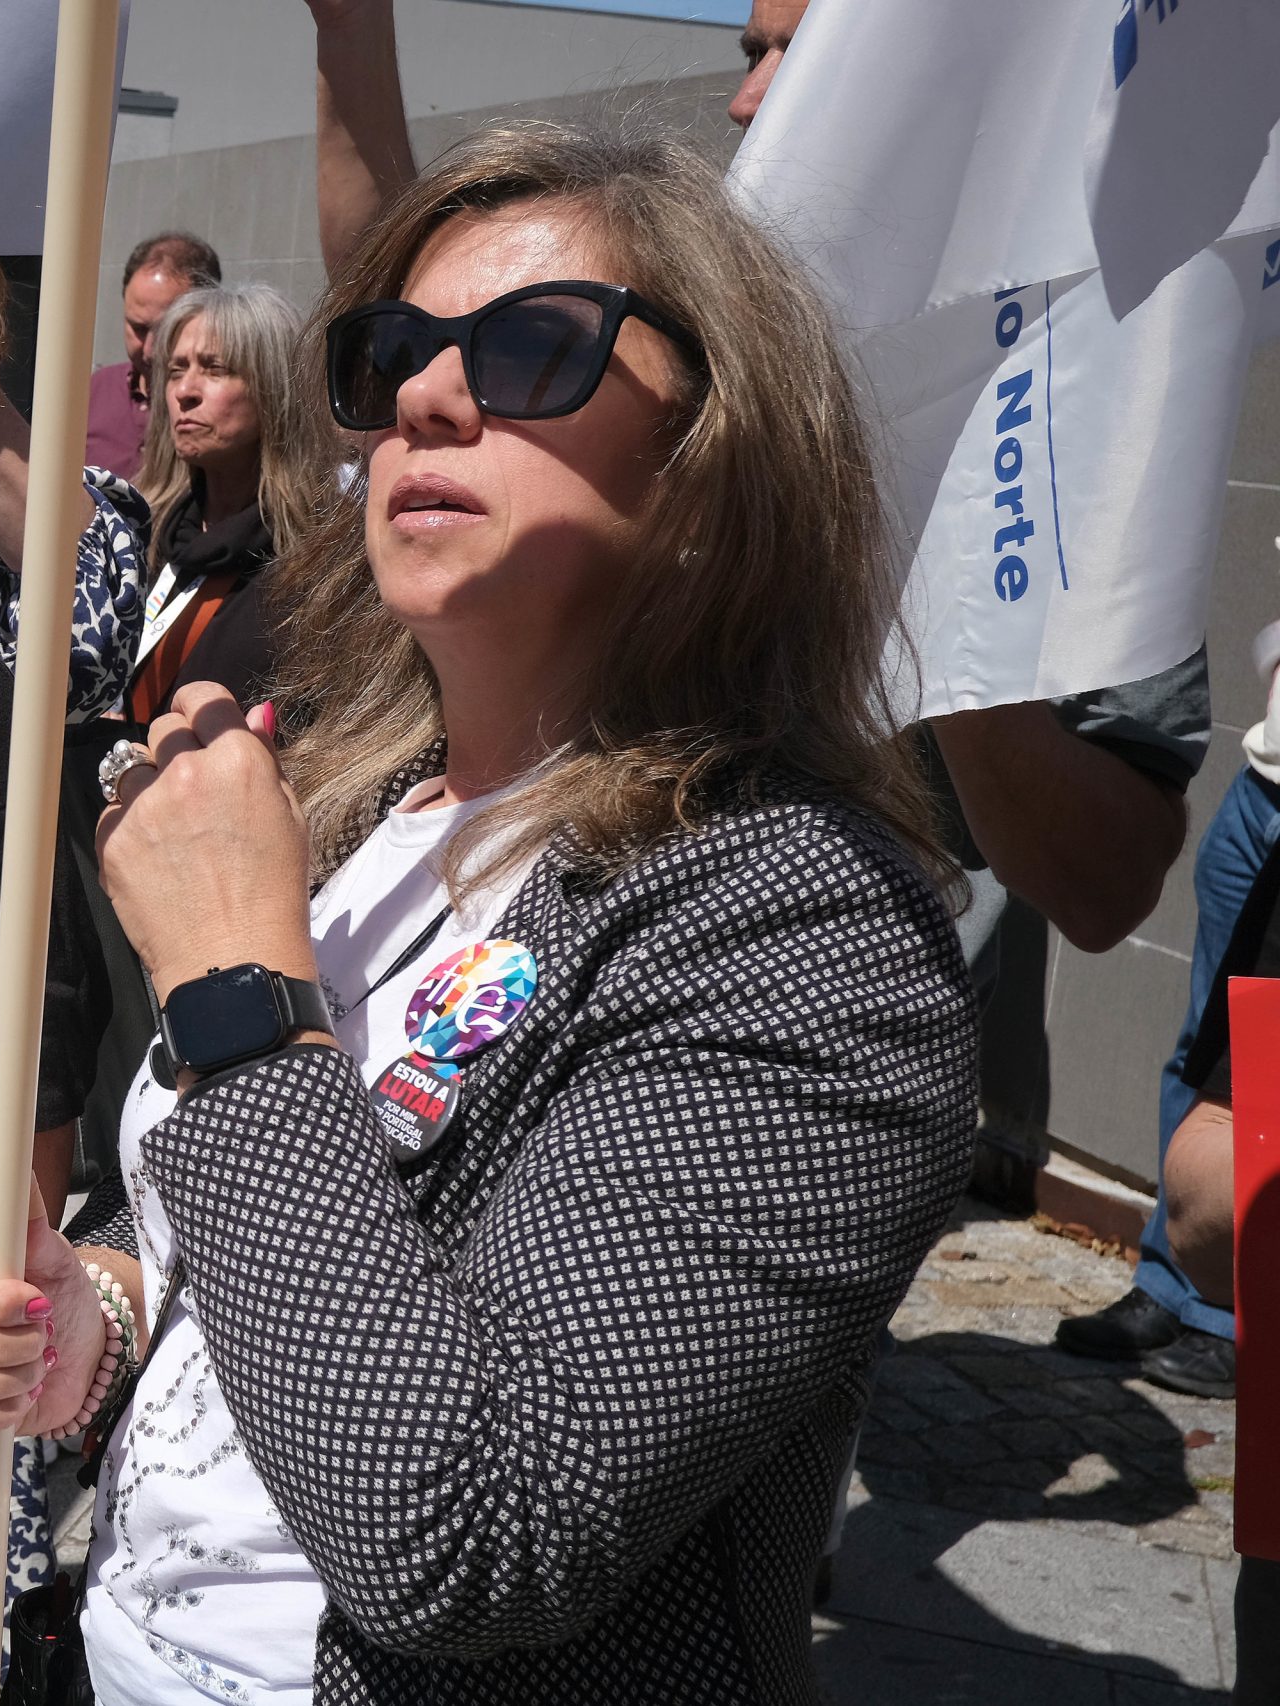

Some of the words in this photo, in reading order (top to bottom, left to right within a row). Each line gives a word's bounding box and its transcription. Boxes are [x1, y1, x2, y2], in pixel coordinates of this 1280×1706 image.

[994, 369, 1035, 602] Norte
[378, 1073, 447, 1123] LUTAR
[392, 1062, 438, 1094] ESTOU
[434, 1085, 450, 1102] A
[382, 1111, 423, 1141] PORTUGAL
[383, 1100, 401, 1116] POR
[399, 1109, 418, 1125] MIM
